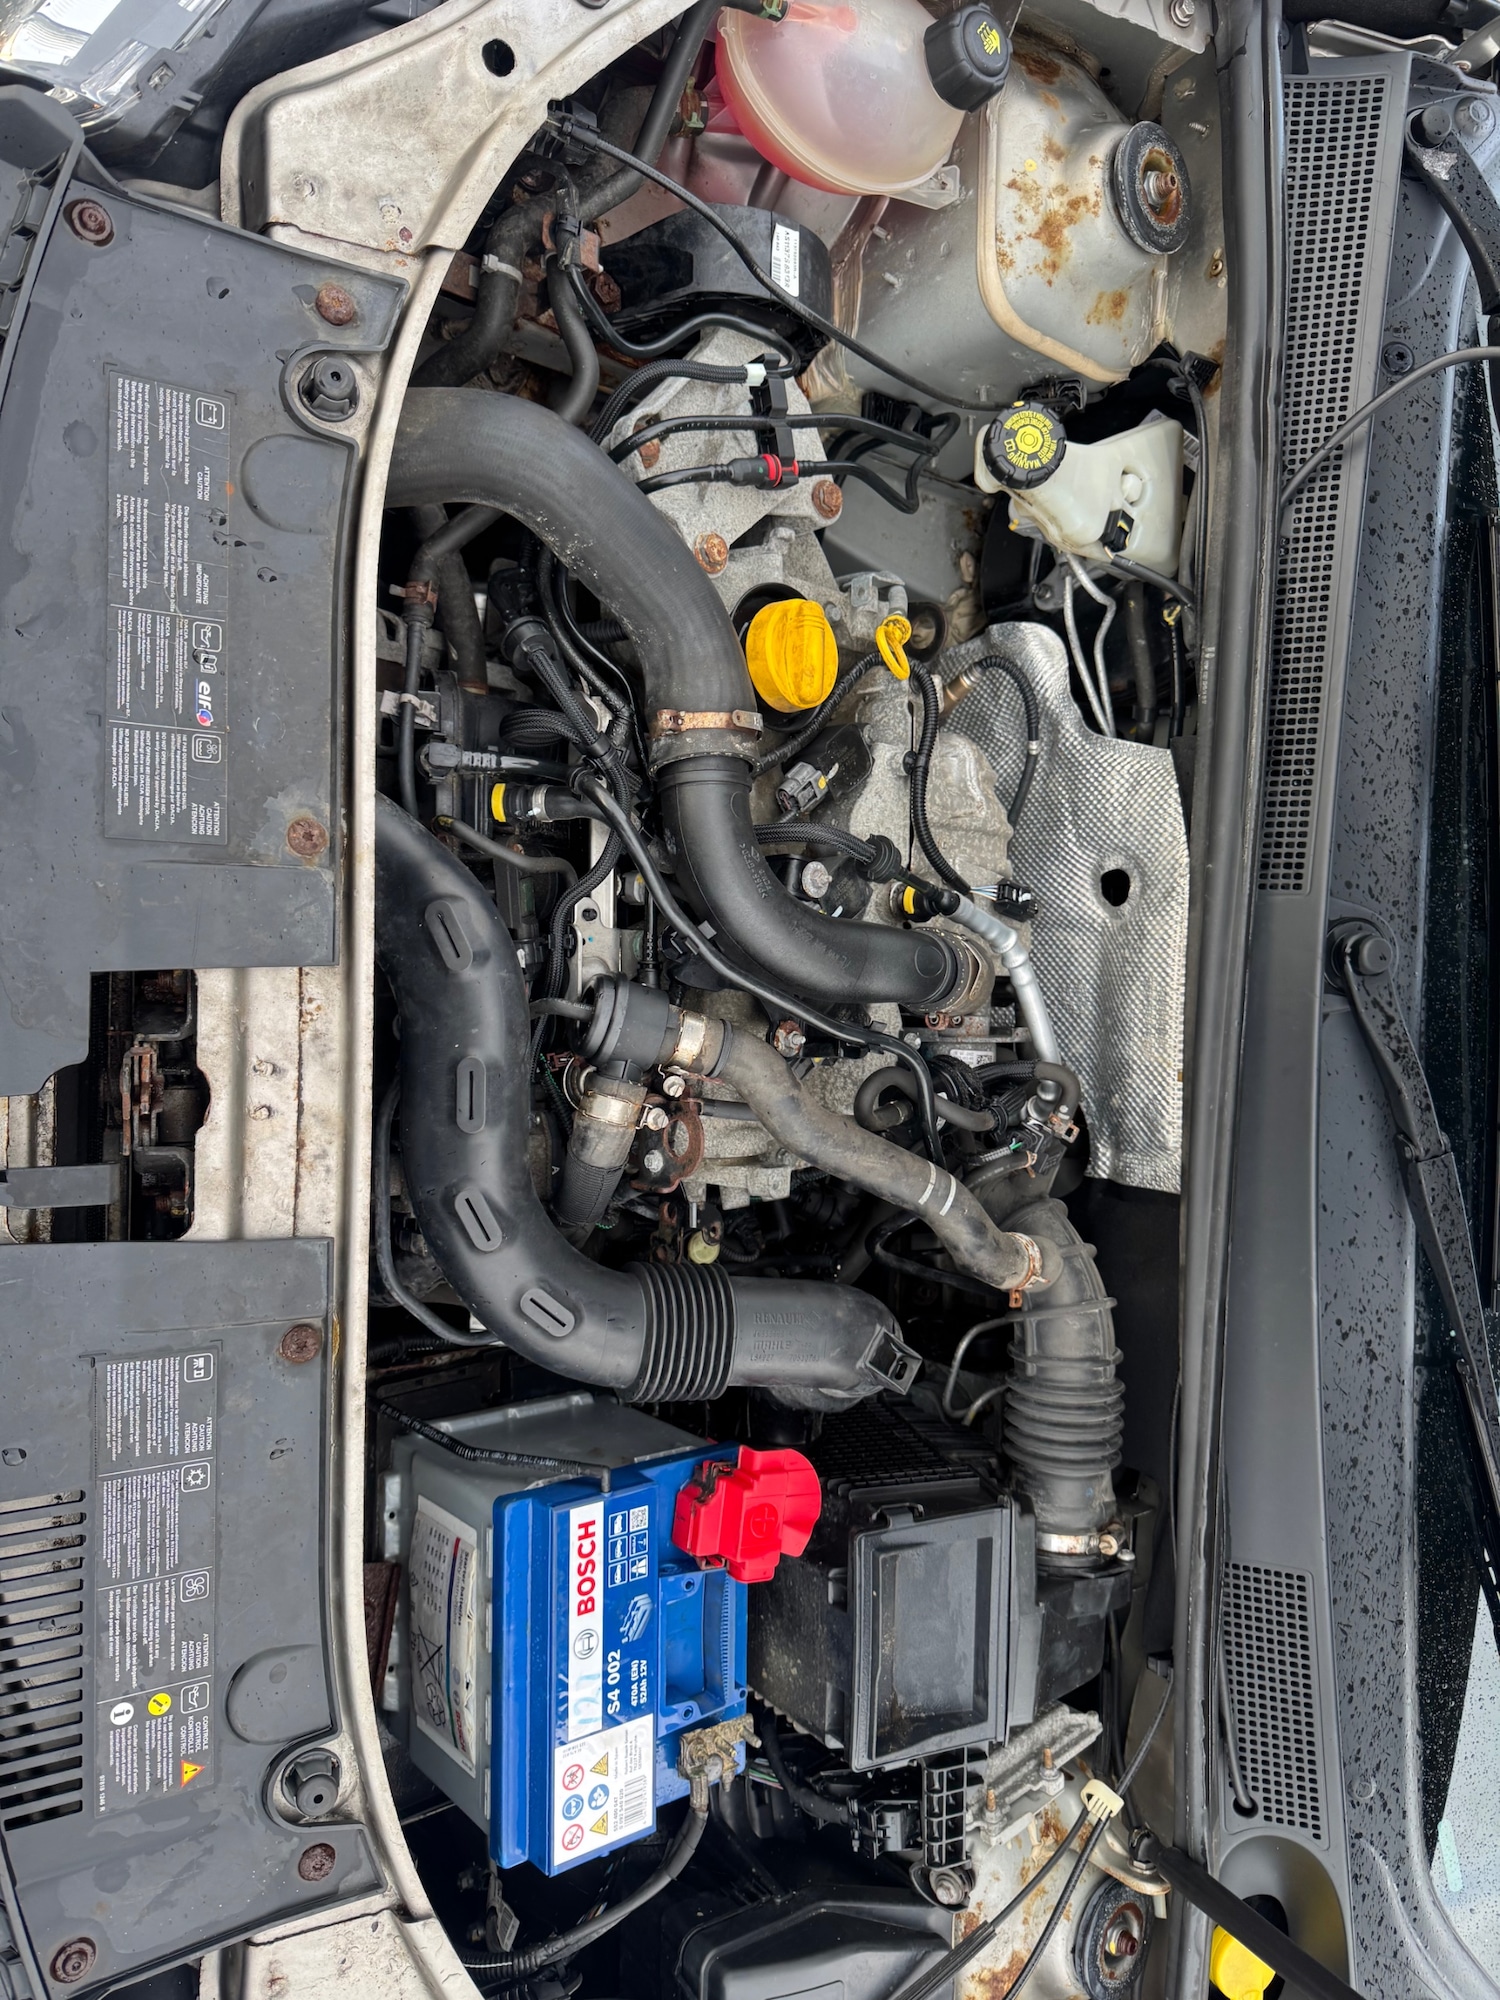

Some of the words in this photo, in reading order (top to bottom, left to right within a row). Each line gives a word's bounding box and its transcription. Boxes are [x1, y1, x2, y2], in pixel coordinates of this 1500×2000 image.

[131, 449, 135, 457] on
[1007, 452, 1041, 469] WARNING
[199, 681, 211, 710] elf
[576, 1519, 597, 1616] BOSCH
[607, 1649, 621, 1685] 002
[631, 1660, 639, 1681] (EN)
[607, 1689, 620, 1714] S4
